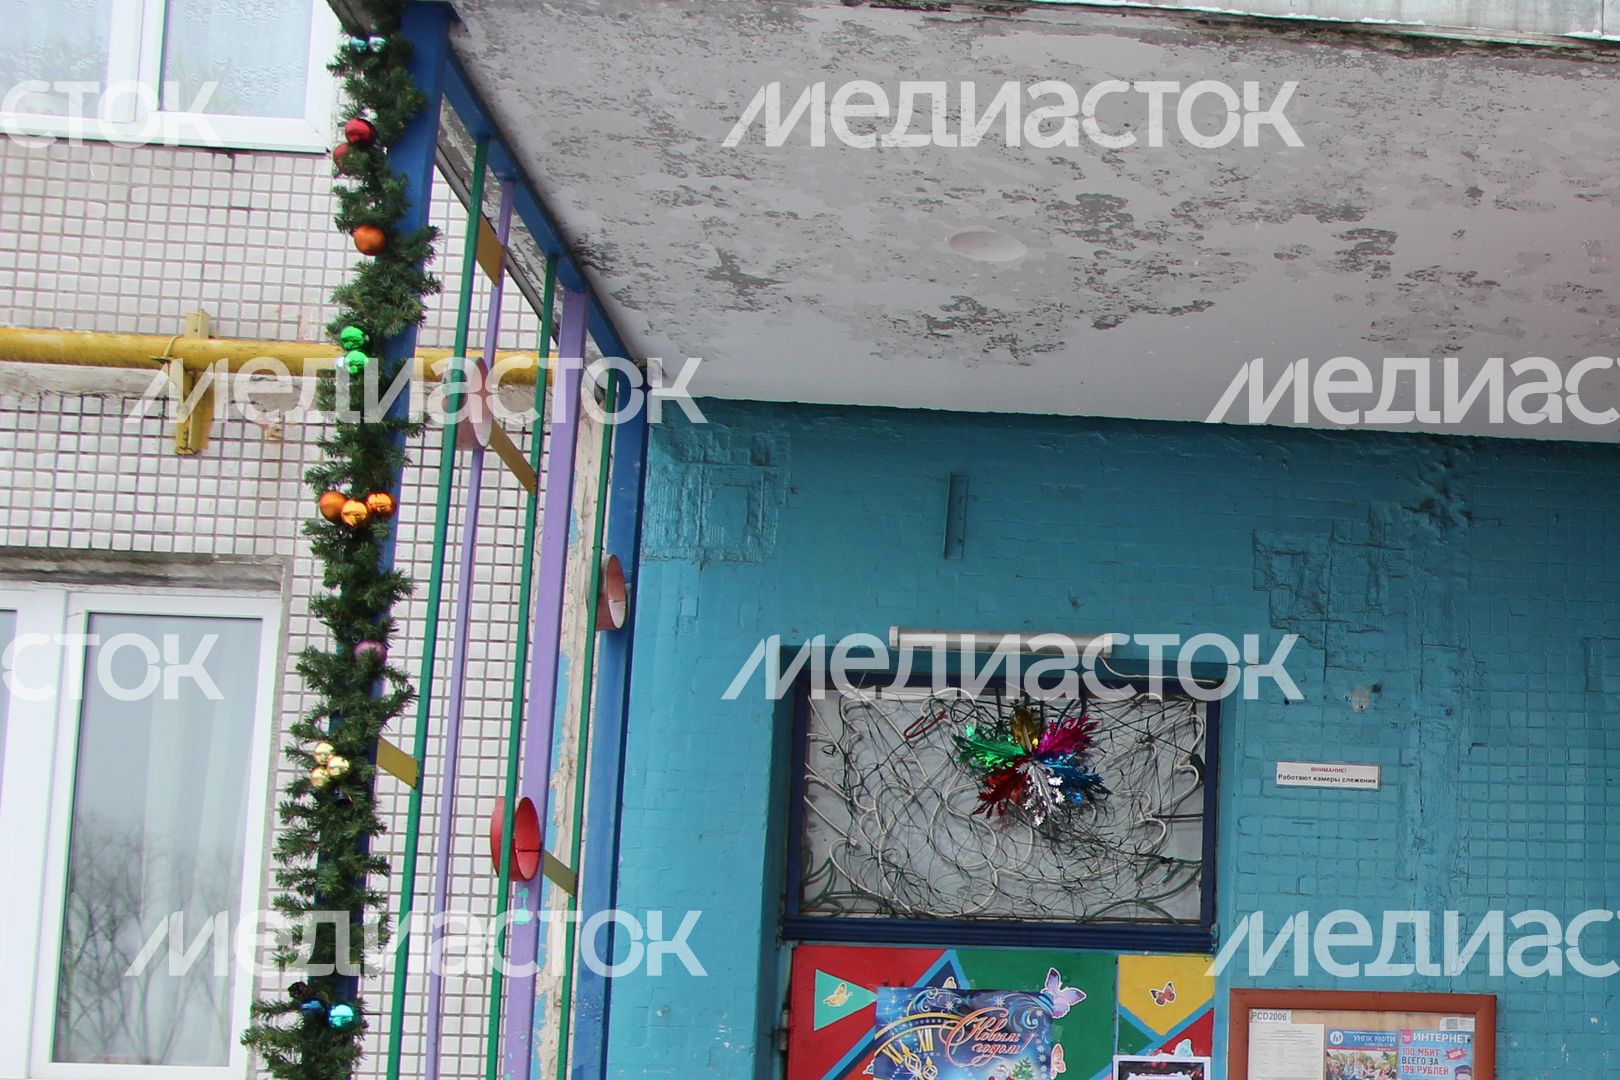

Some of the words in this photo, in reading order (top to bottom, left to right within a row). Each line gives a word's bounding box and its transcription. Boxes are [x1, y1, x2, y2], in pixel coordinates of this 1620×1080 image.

[1310, 766, 1347, 774] ВНИМАНИЕ!
[1278, 773, 1312, 782] Работают
[1313, 776, 1341, 784] камеры
[1413, 1032, 1471, 1043] ИНТЕРНЕТ
[1402, 1047, 1415, 1055] 100
[1418, 1047, 1440, 1056] МБИТ
[1401, 1056, 1426, 1065] ВСЕГО
[1428, 1057, 1439, 1066] ЗА
[1402, 1065, 1414, 1073] 199
